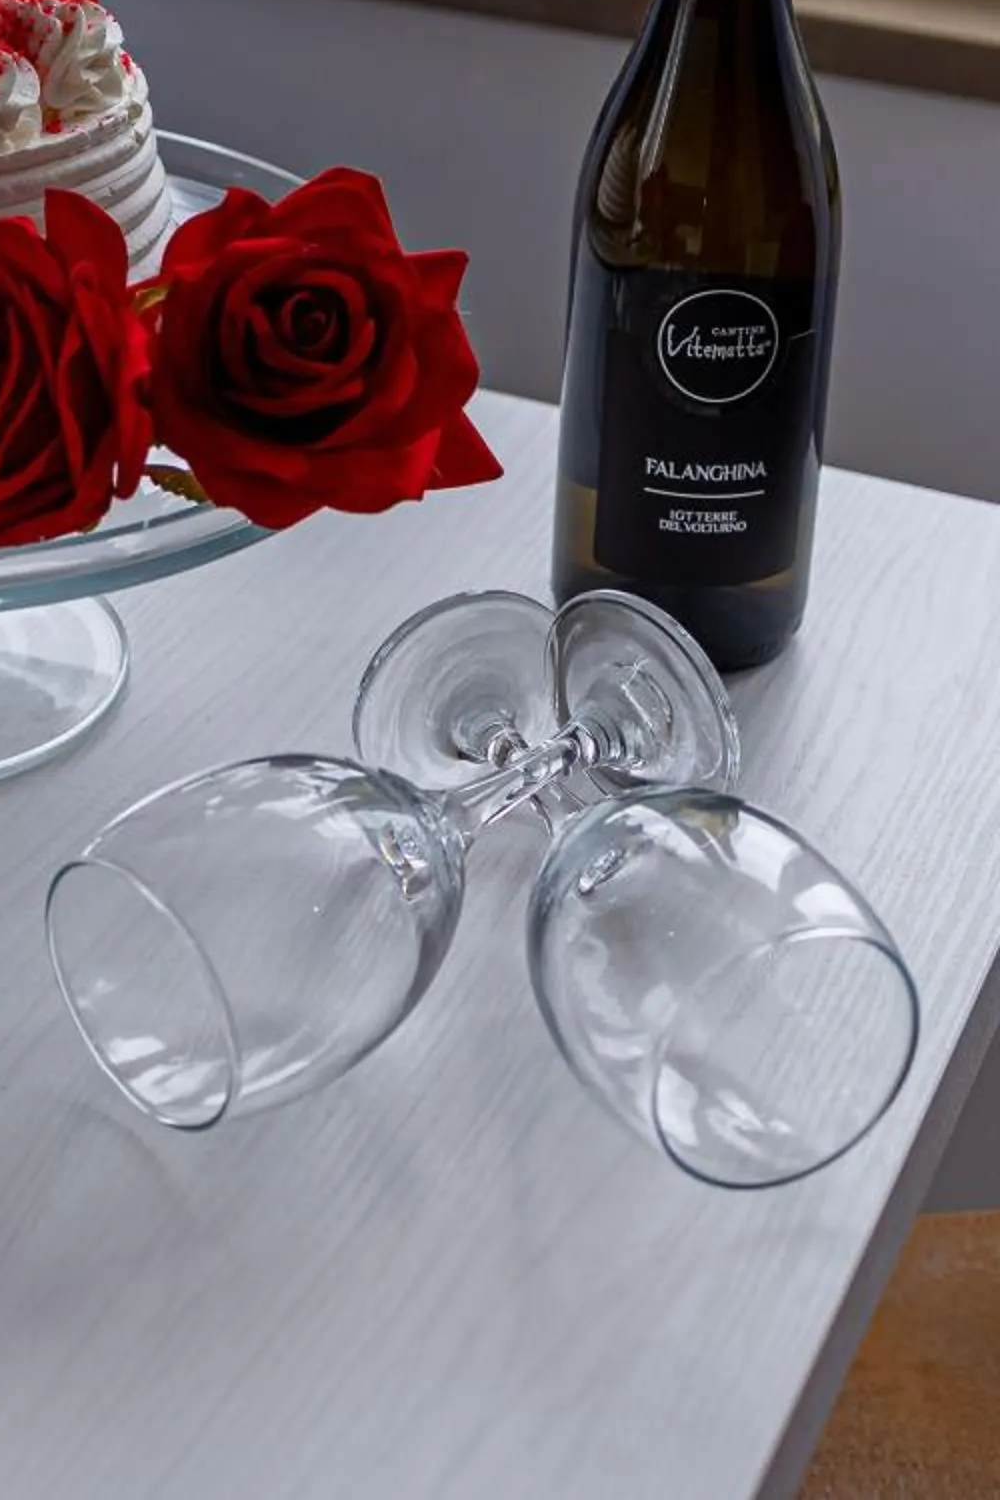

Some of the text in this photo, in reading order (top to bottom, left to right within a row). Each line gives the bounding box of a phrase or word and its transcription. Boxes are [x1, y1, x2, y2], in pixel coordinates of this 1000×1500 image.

[711, 325, 766, 337] CANTINE
[645, 456, 768, 483] FALANGHINA
[669, 508, 738, 523] IGT TERRE
[659, 518, 747, 534] DEL VOLTURNO
